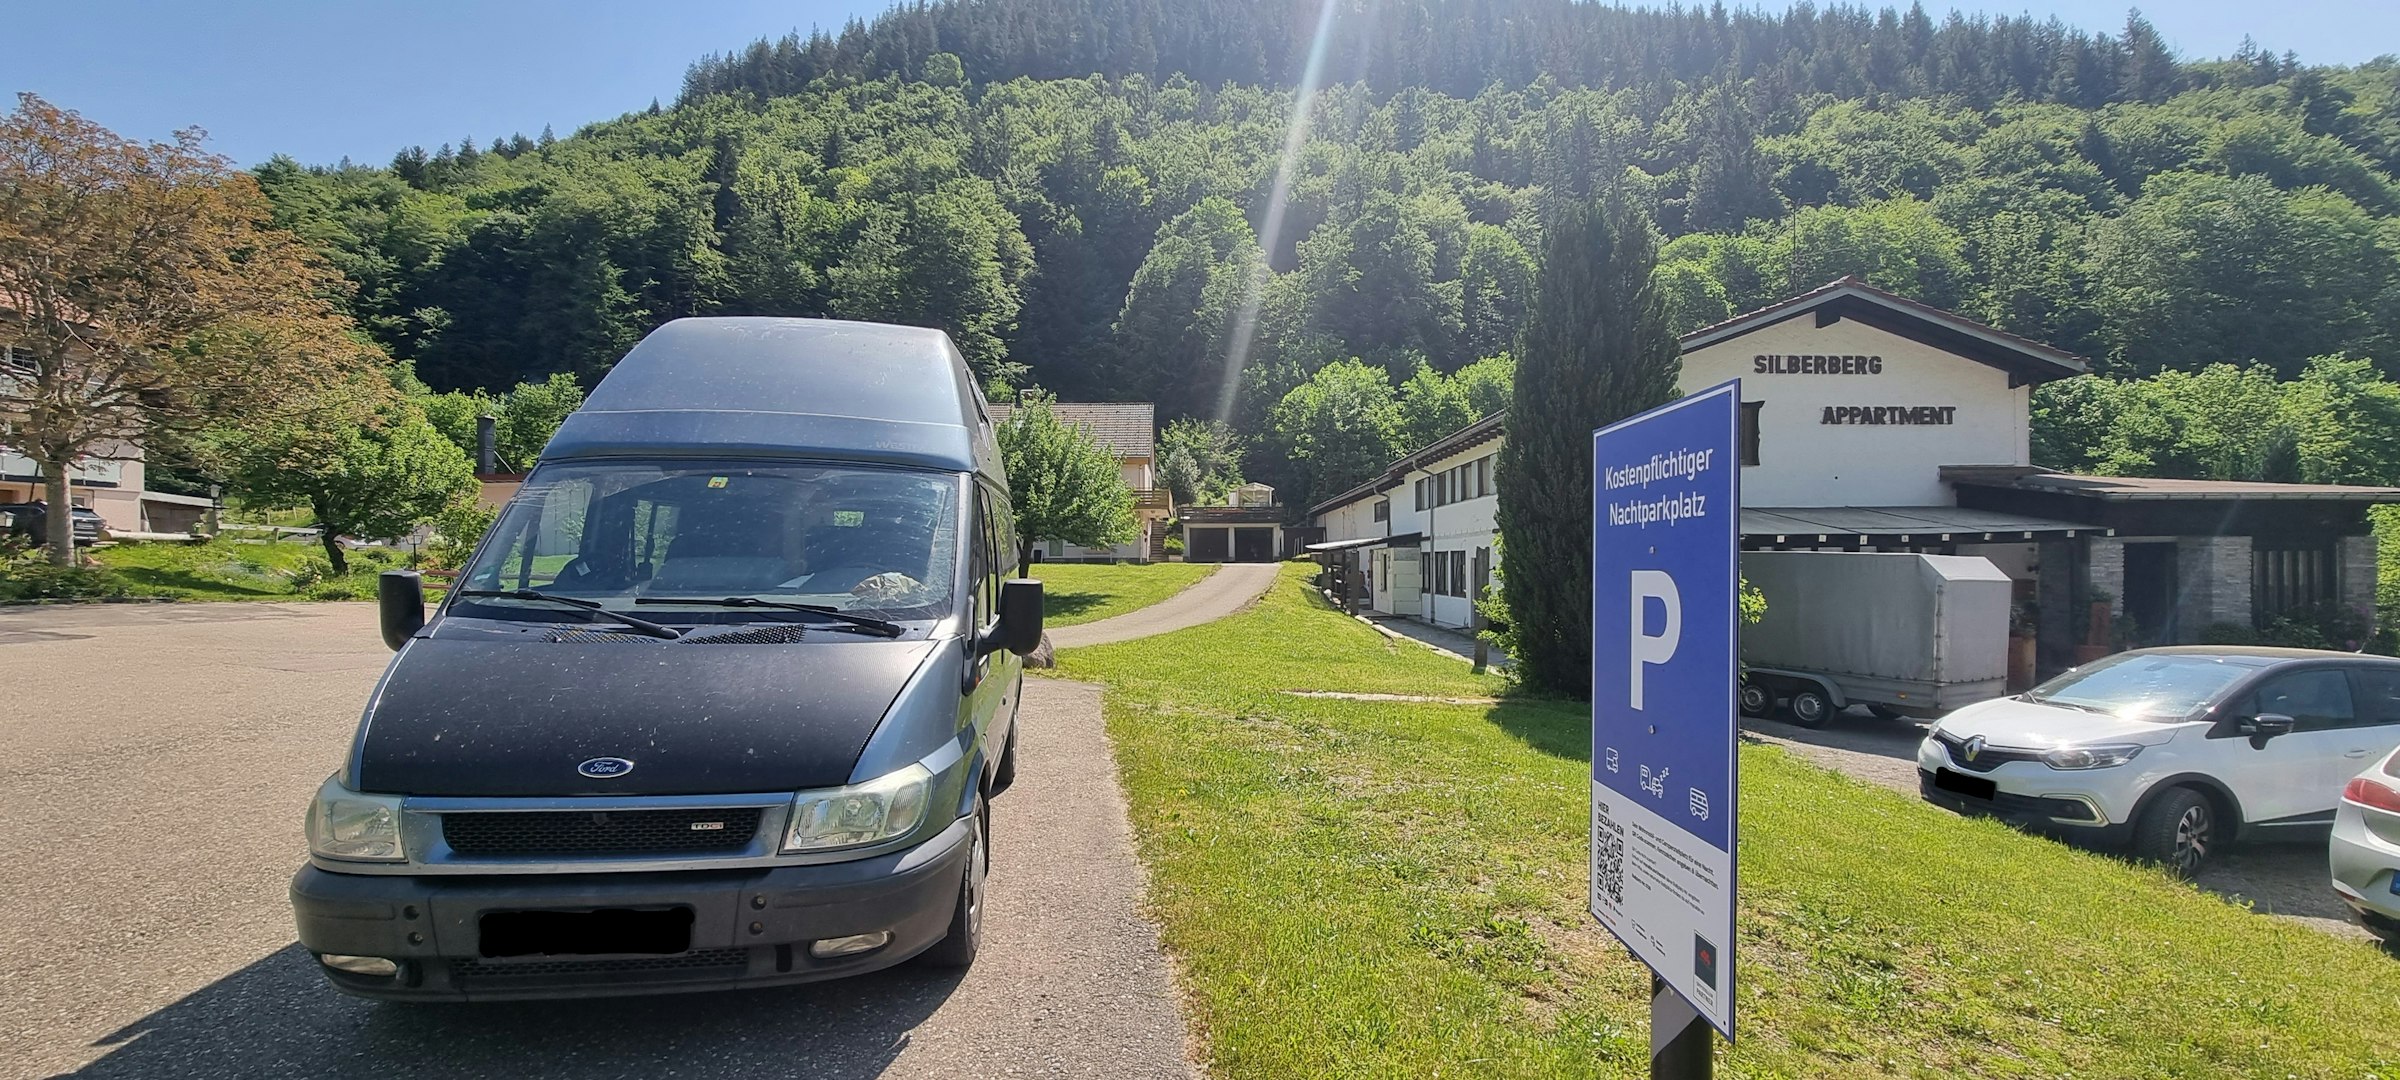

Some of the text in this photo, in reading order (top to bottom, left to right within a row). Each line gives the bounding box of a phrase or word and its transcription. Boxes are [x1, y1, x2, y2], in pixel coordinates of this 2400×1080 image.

[1754, 355, 1882, 374] SILBERBERG
[1821, 406, 1956, 425] APPARTMENT
[1605, 447, 1713, 490] Kostenpflichtiger
[1609, 491, 1706, 530] Nachtparkplatz
[1630, 570, 1682, 711] P
[590, 761, 620, 773] Ford
[1598, 800, 1609, 815] HIER
[1598, 812, 1624, 837] BEZAHLEN
